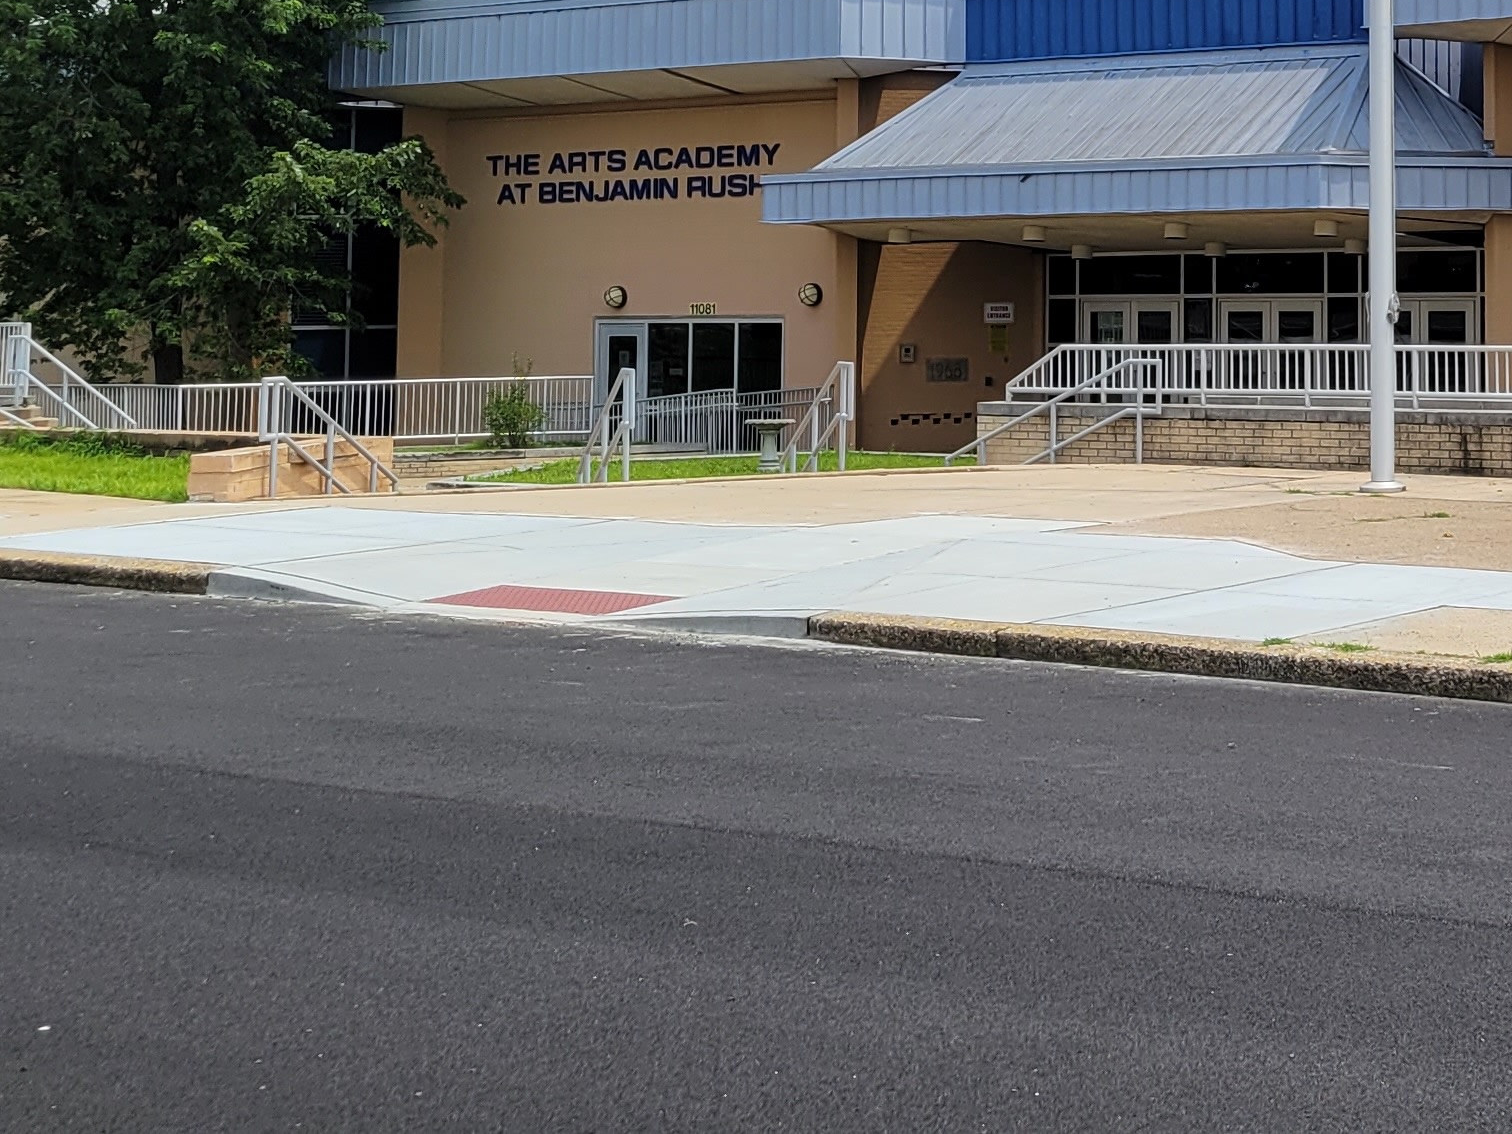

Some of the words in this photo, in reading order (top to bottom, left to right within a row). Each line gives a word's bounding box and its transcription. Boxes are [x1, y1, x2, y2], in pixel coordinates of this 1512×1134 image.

[486, 154, 541, 176] THE
[548, 149, 627, 174] ARTS
[633, 143, 781, 170] ACADEMY
[497, 183, 532, 205] AT
[538, 177, 678, 204] BENJAMIN
[690, 303, 716, 314] 11081
